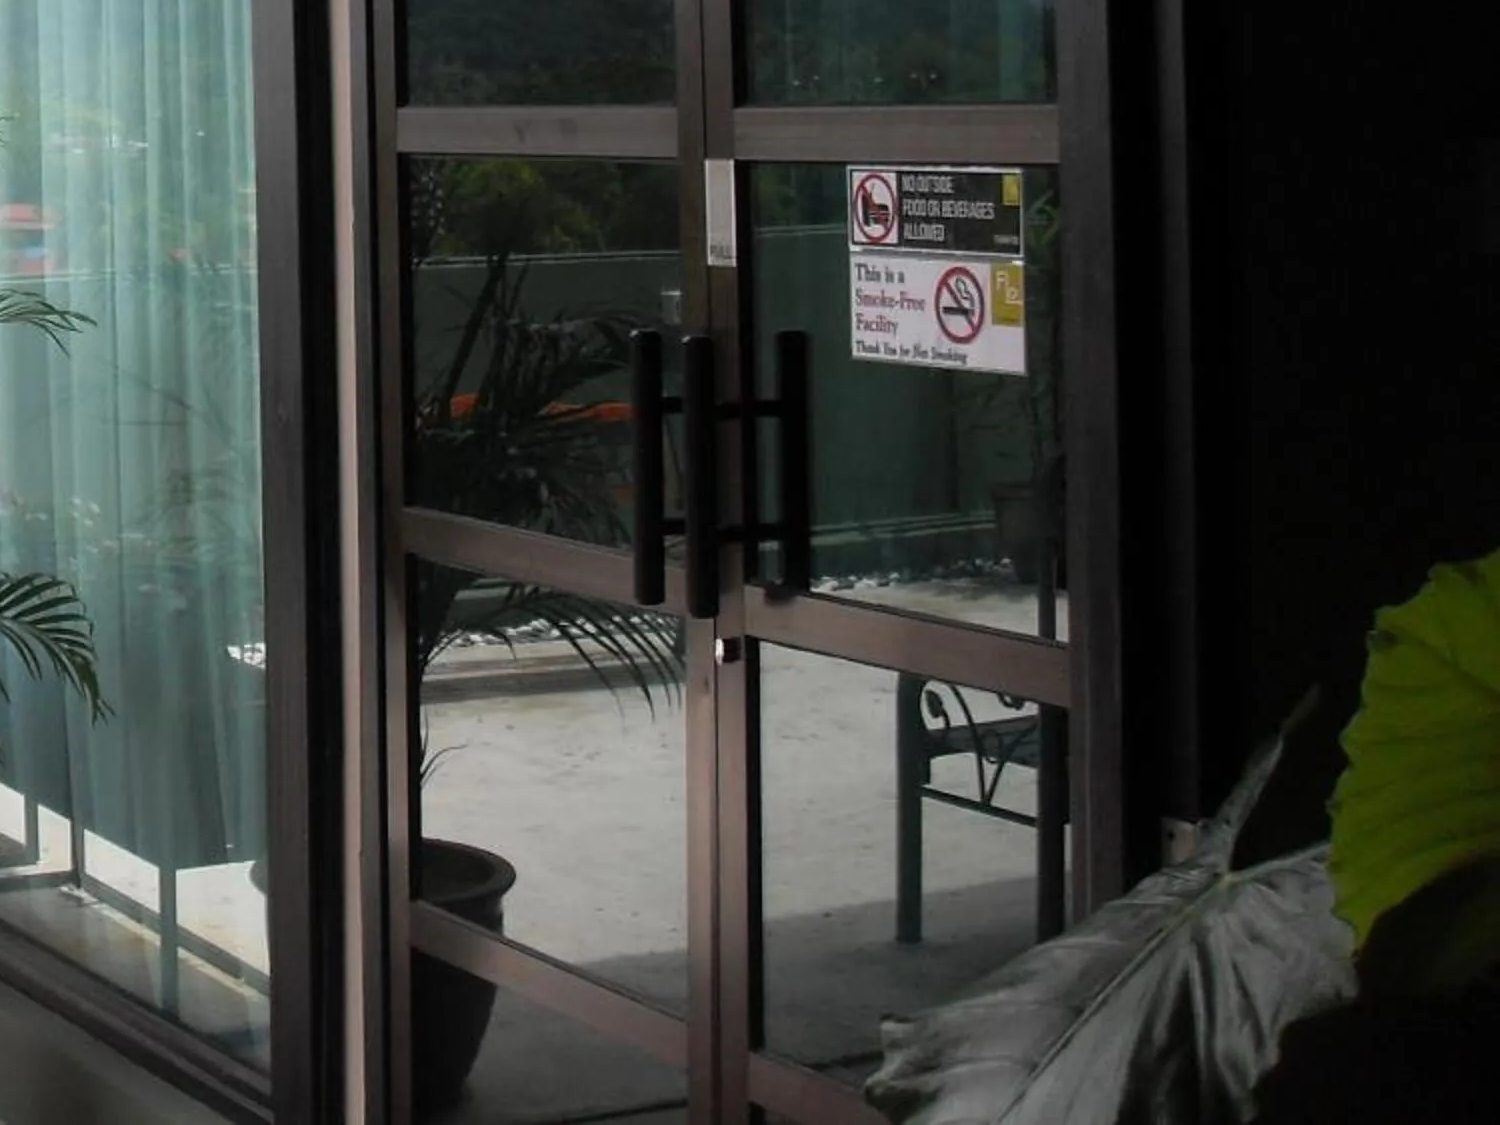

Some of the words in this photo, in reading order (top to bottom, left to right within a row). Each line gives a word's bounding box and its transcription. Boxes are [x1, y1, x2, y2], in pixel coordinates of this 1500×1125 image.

[902, 175, 915, 192] NO
[902, 198, 926, 216] FOOD
[927, 200, 940, 217] OR
[941, 200, 995, 220] BEVERAGES
[903, 223, 945, 241] ALLOWED
[855, 263, 881, 283] This
[885, 267, 896, 283] is
[898, 272, 905, 284] a
[855, 288, 926, 312] Smoke-Free
[855, 313, 899, 336] Facility
[855, 340, 880, 354] Thank
[883, 342, 897, 356] You
[932, 346, 968, 365] Smoking
